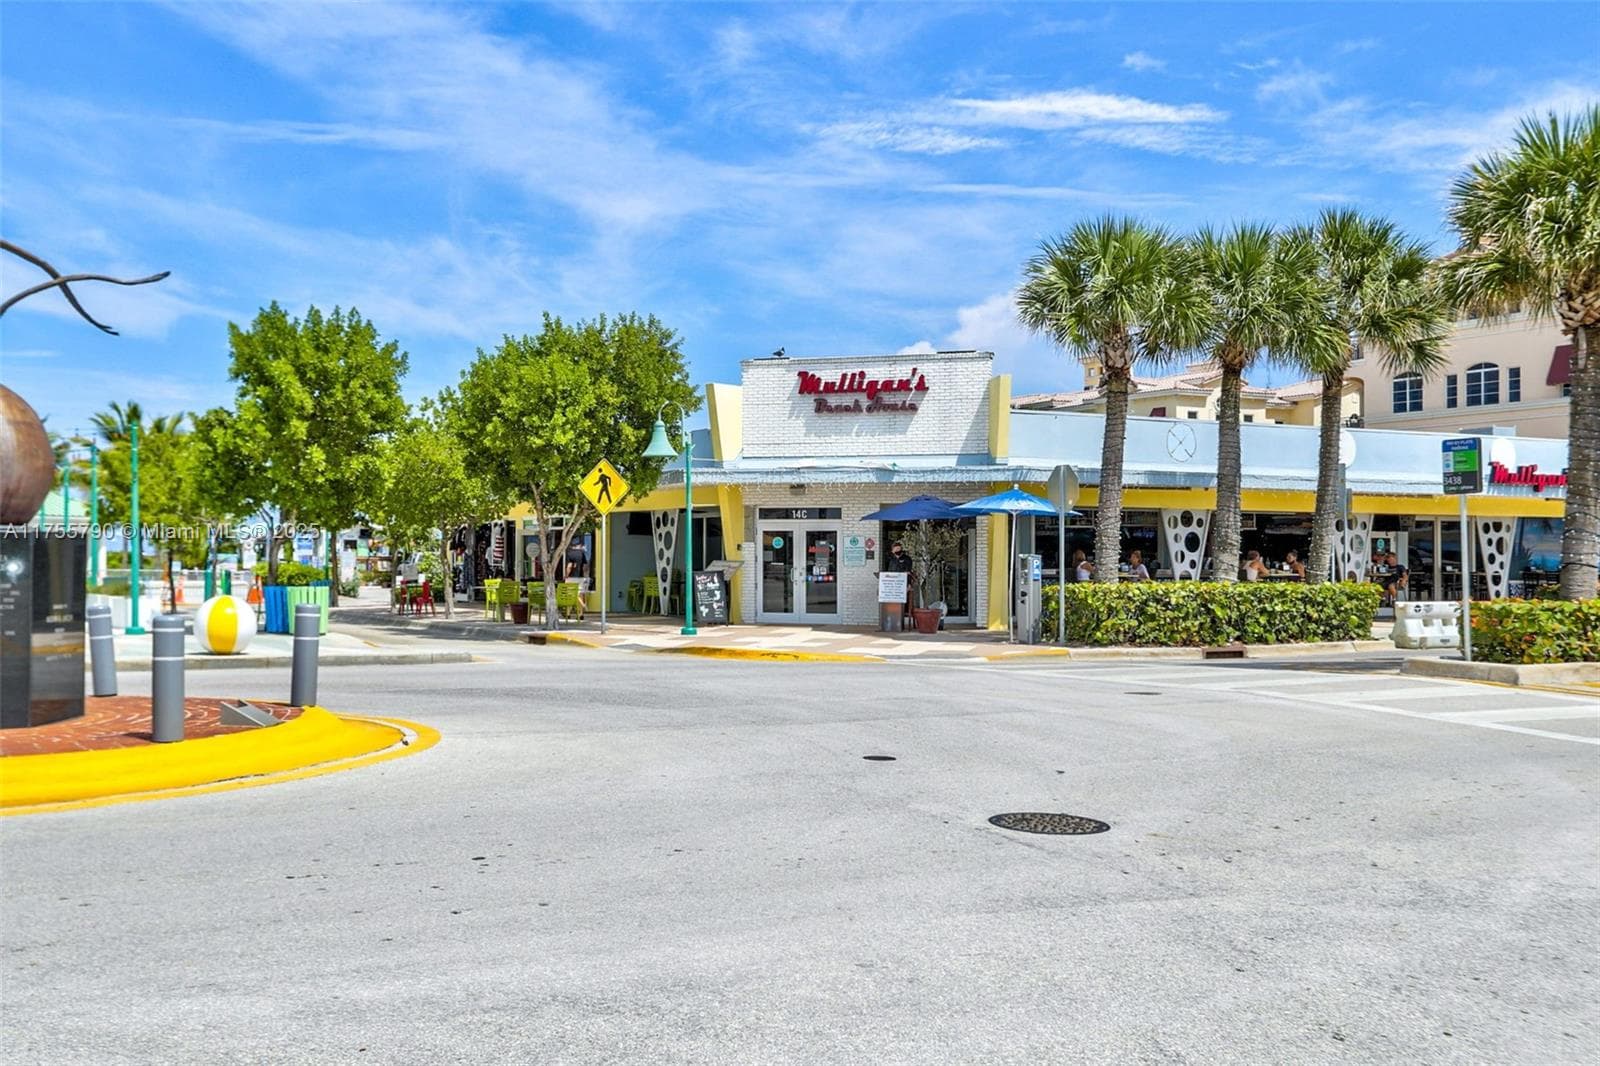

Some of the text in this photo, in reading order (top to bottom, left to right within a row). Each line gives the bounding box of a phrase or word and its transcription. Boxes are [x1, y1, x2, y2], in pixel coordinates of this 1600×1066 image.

[797, 367, 929, 400] Mulligan's
[813, 396, 919, 413] Beach House
[1488, 461, 1568, 492] Mulligan
[792, 510, 808, 519] 14C
